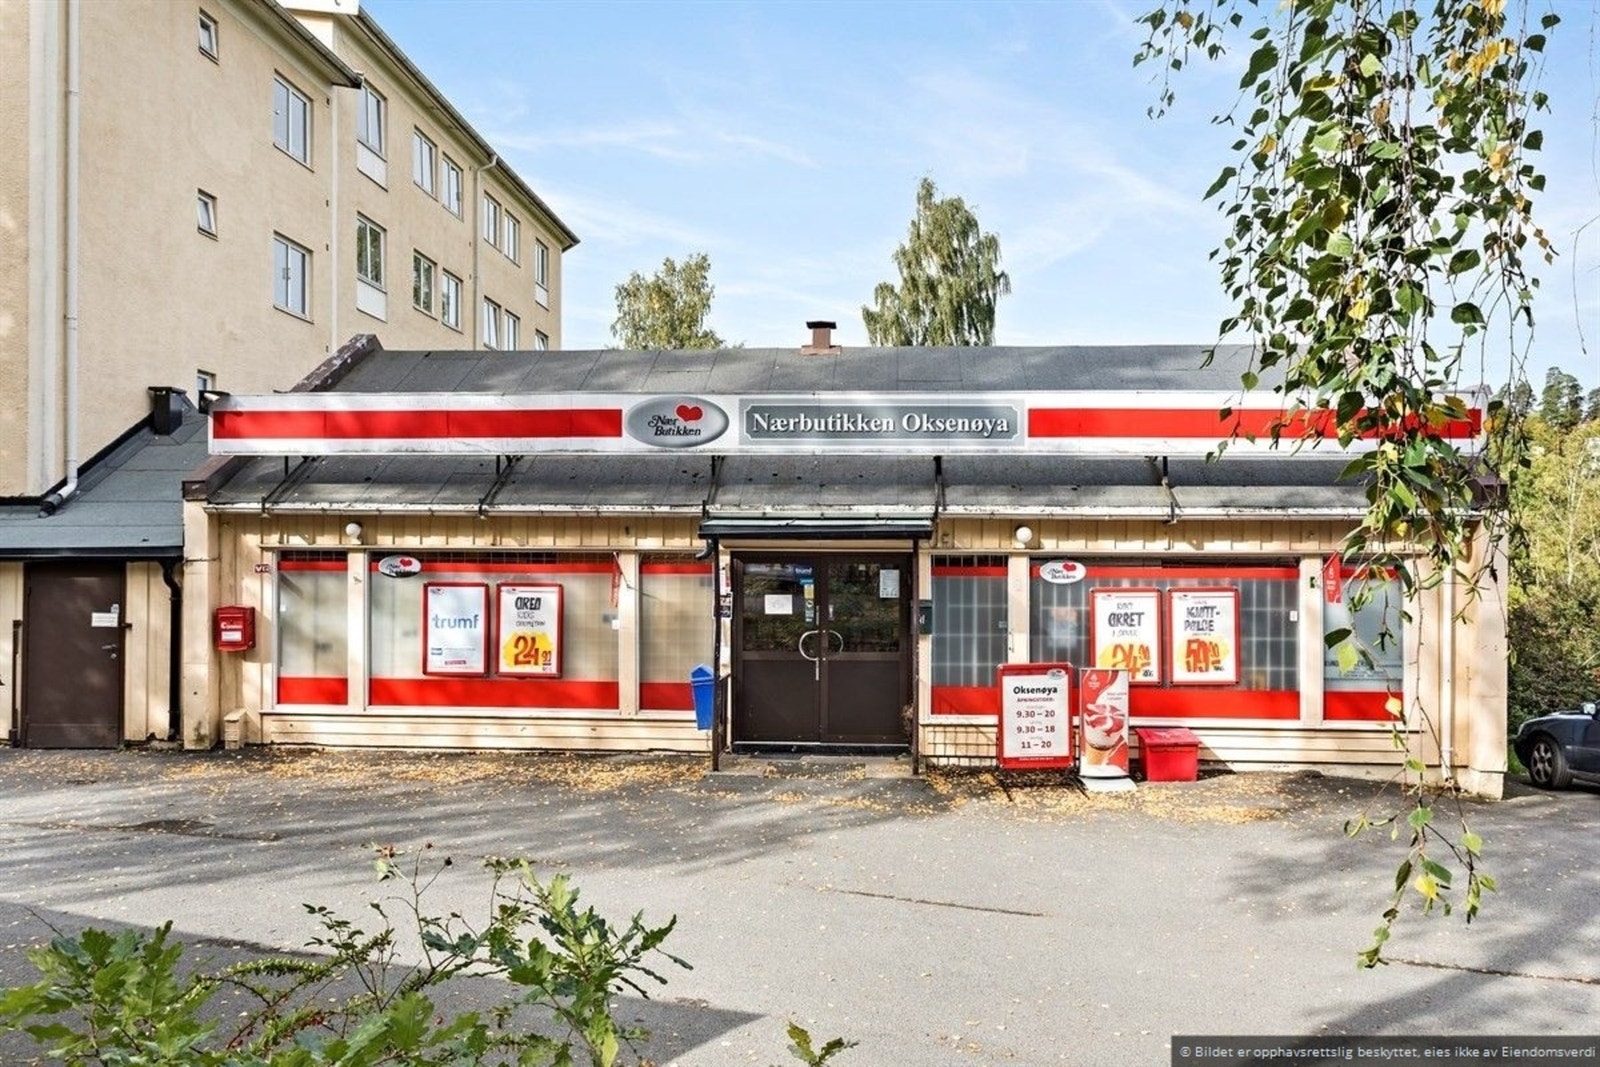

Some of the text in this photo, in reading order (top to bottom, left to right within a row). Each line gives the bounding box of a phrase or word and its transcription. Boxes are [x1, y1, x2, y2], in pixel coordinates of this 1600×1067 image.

[648, 414, 678, 427] Nær
[752, 413, 1009, 437] Nærbutikken Oksenøya
[654, 426, 702, 436] Butikken
[433, 614, 479, 628] trumf
[514, 635, 540, 665] 24
[1013, 685, 1058, 695] Oksenøya
[1016, 710, 1036, 718] 9.30
[1044, 709, 1055, 718] 20
[1016, 725, 1036, 734] 9.30
[1045, 725, 1055, 733] 18
[1021, 741, 1031, 749] 11
[1041, 740, 1052, 748] 20
